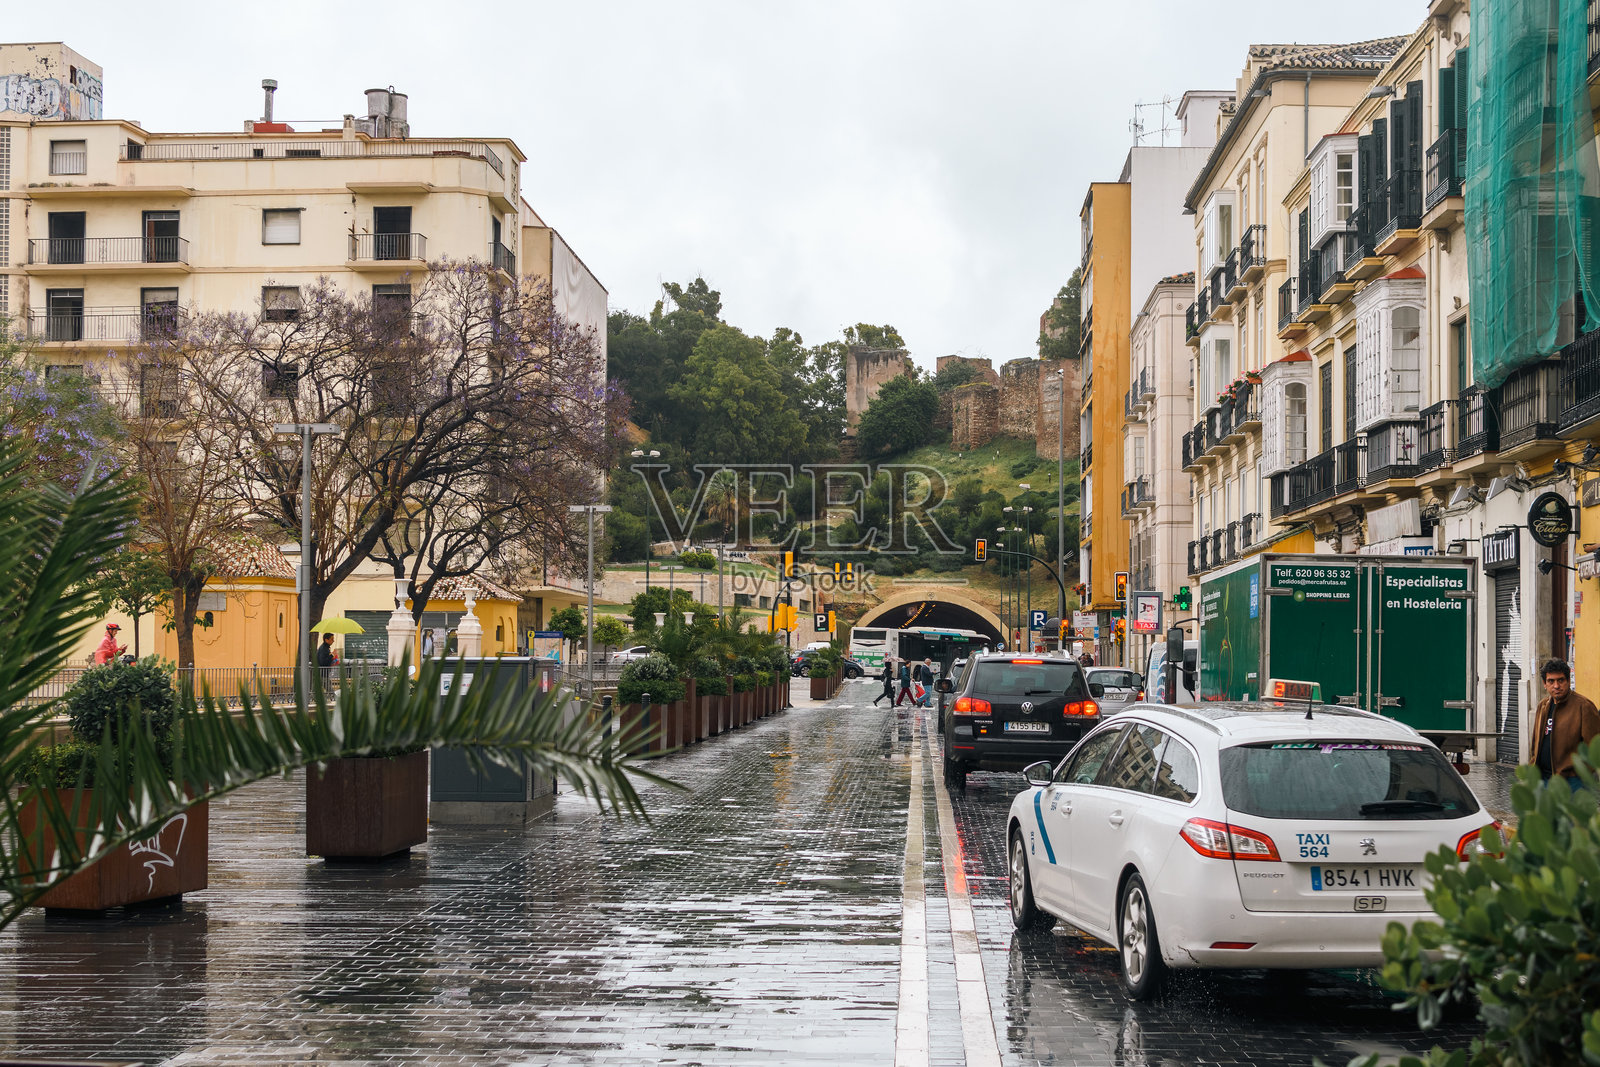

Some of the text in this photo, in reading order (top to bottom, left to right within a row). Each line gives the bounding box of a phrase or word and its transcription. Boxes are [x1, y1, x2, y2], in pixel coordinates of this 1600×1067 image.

[1275, 568, 1351, 579] Telf. 620 96 35 32
[1386, 575, 1464, 590] Especialistas
[1386, 597, 1462, 610] en Hosteleria
[816, 615, 827, 628] P
[1286, 683, 1310, 697] TAXI
[1010, 722, 1029, 730] 4155
[1296, 834, 1330, 845] TAXI
[1299, 846, 1329, 858] 564
[1324, 869, 1371, 887] 8541
[1379, 869, 1415, 887] HVK
[1357, 897, 1383, 909] SP
